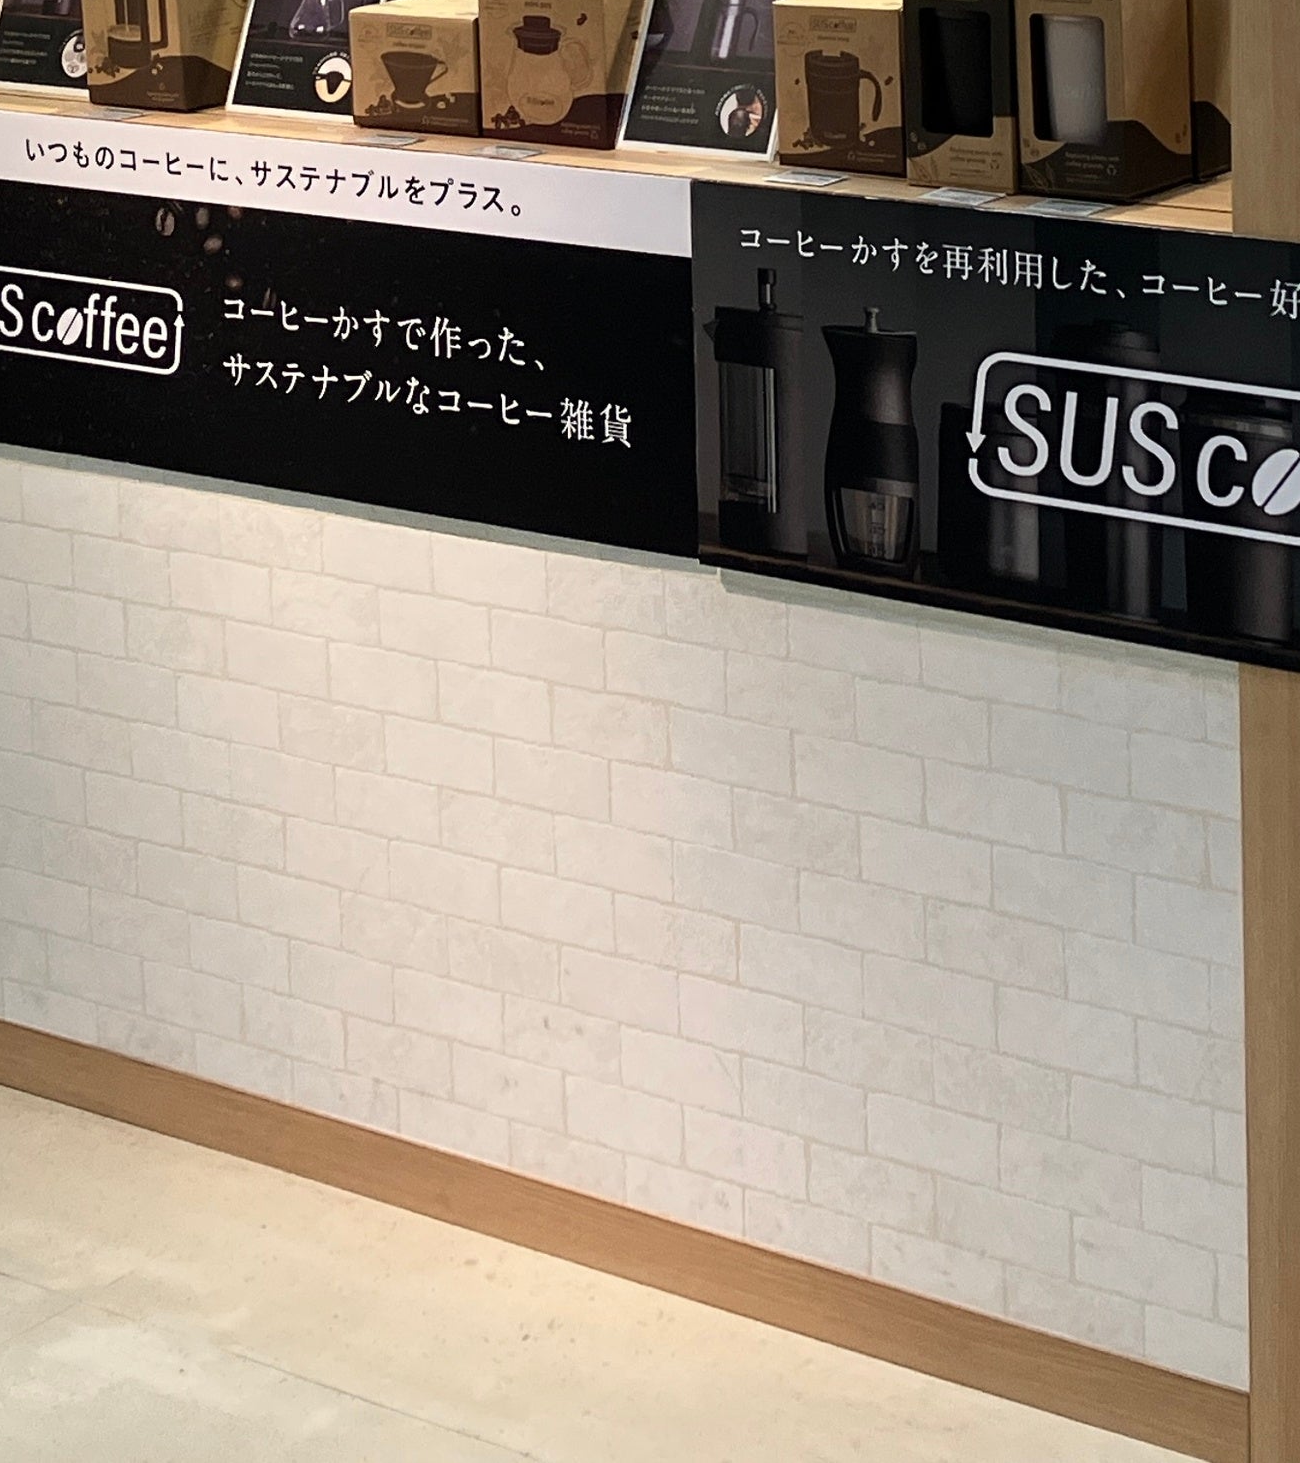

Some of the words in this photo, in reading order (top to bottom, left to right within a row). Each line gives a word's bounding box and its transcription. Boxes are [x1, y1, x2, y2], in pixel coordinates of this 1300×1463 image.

[24, 136, 524, 218] いつものコーヒーに、サステナブルをプラス。
[223, 295, 546, 371] コーヒーかすで作った、
[223, 353, 633, 448] サステナブルなコーヒー雑貨
